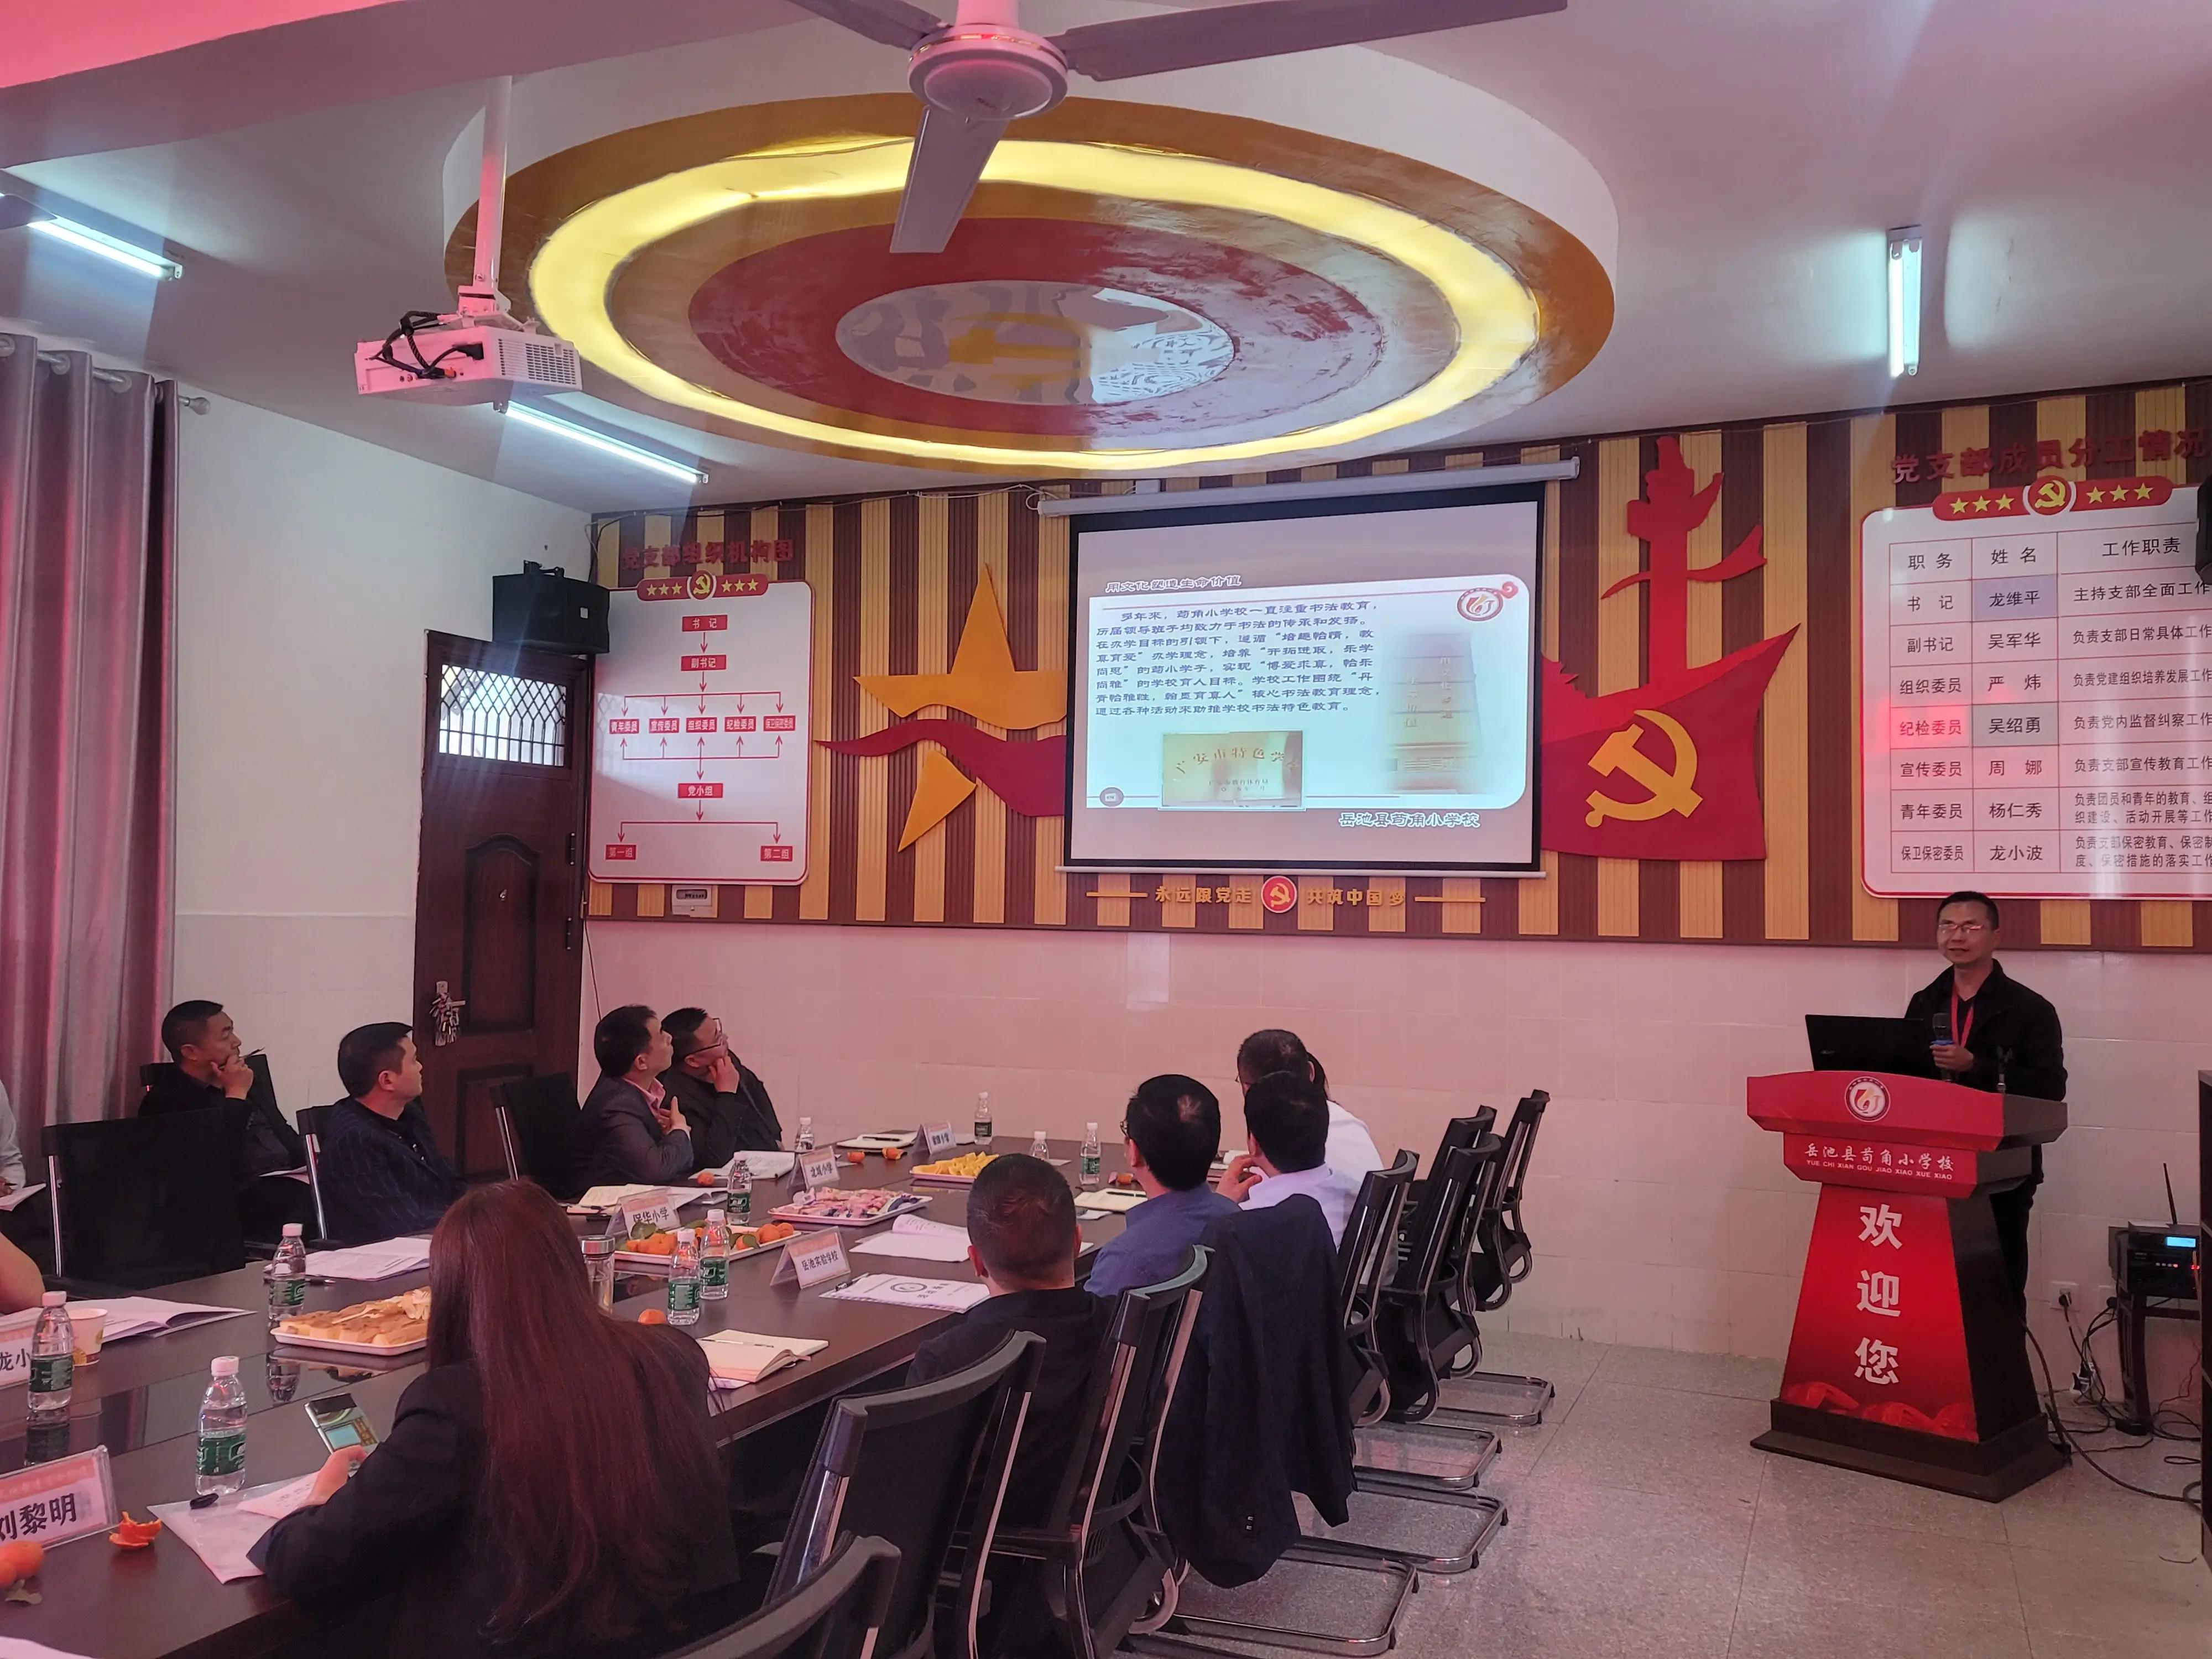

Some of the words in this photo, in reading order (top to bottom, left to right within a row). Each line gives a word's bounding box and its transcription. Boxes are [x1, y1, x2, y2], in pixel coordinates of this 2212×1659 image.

[1891, 429, 2208, 483] 党支部成员分工情况
[2102, 538, 2181, 557] 工作职责
[1989, 589, 2041, 608] 龙维平
[2074, 581, 2210, 602] 主持支部全面工作
[1907, 636, 1953, 653] 副书记
[1988, 632, 2041, 649] 吴军华
[2073, 624, 2212, 645] 负责支部日常具体工作
[691, 658, 716, 669] 副书记
[1900, 677, 1961, 695] 组织委员
[2073, 669, 2212, 687] 负责党建组织培养发展工作
[687, 720, 715, 731] 组织委员
[726, 719, 754, 730] 纪检委员
[1900, 719, 1961, 737] 纪检委员
[1989, 717, 2041, 734] 吴绍勇
[2074, 712, 2212, 730] 负责党内监督纠察工作
[1901, 761, 1961, 778] 宣传委员
[2074, 756, 2212, 772] 负责支部宣传教育工作
[688, 785, 713, 796] 党小组
[2074, 791, 2212, 807] 负责团员和青年的教育、组
[1901, 804, 1962, 820] 青年委员
[1989, 802, 2043, 818] 杨仁秀
[764, 848, 790, 859] 第二组
[1901, 844, 1963, 862] 保卫保密委员
[1990, 844, 2043, 862] 龙小波
[1155, 885, 1252, 904] 永远跟党走
[1307, 888, 1407, 906] 共筑中国梦
[1804, 1142, 1954, 1171] 岳池县苟角小学校
[1854, 1203, 1903, 1385] 欢迎您
